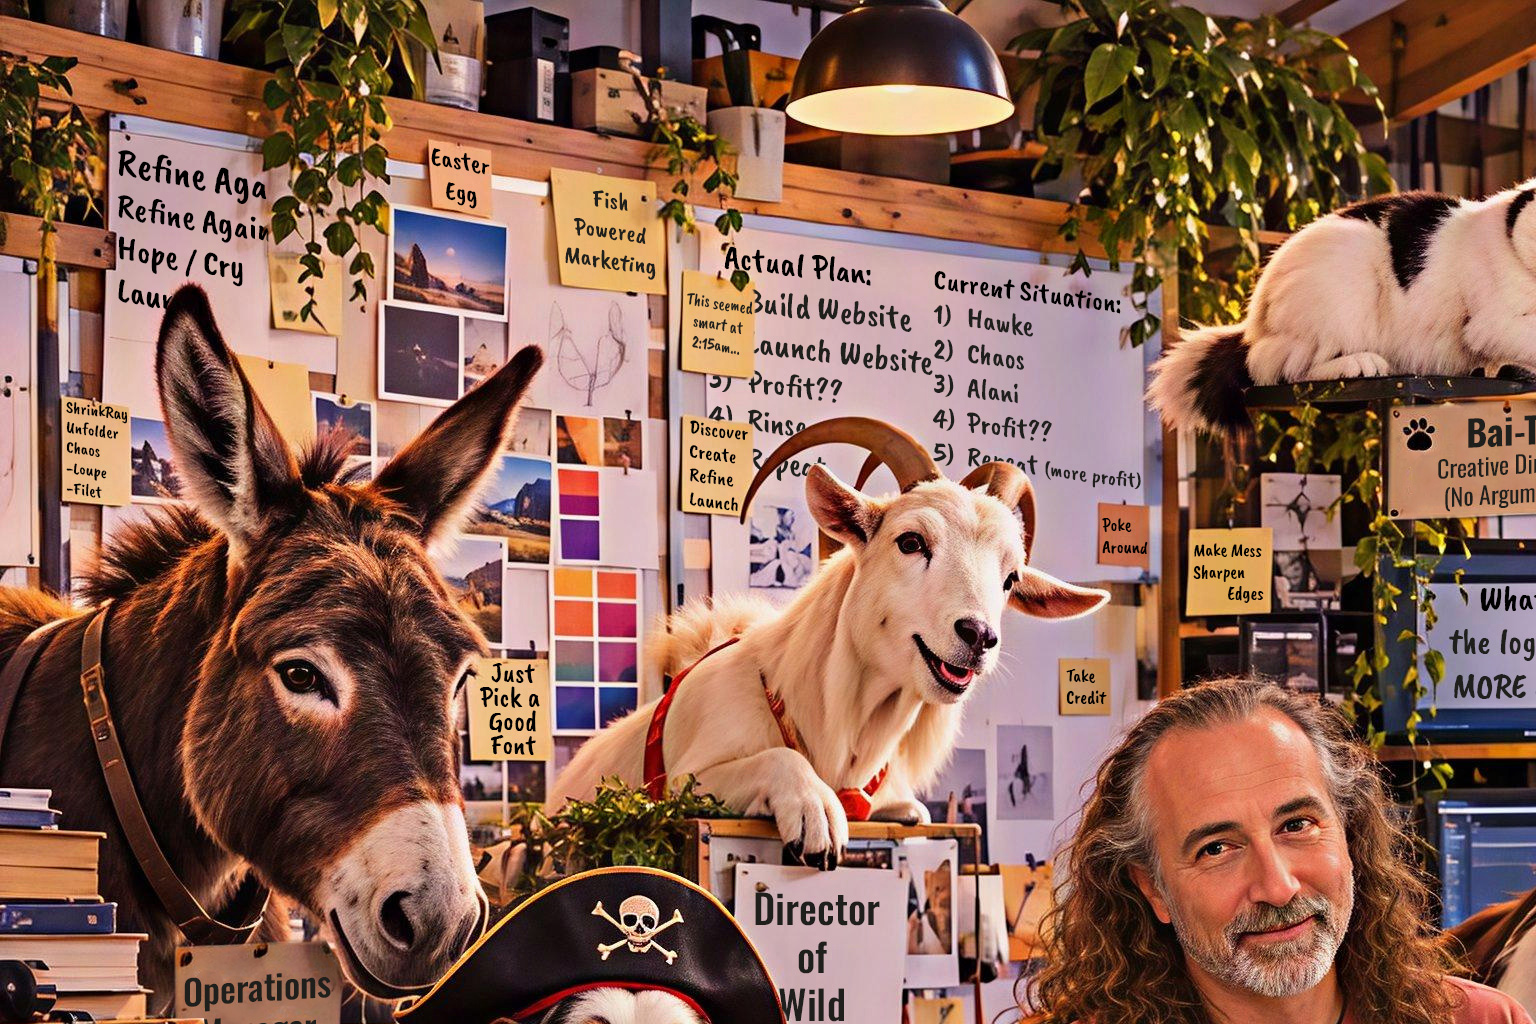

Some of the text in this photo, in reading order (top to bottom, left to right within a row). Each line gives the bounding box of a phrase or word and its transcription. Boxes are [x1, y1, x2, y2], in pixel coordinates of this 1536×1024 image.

[118, 150, 206, 191] Refine
[431, 148, 490, 175] Easter
[446, 182, 477, 208] Egg
[593, 190, 628, 211] Fish
[118, 195, 269, 243] Refine Again
[574, 218, 646, 244] Powered
[119, 236, 178, 274] Hope
[204, 252, 243, 286] Cry
[565, 247, 656, 280] Marketing
[724, 247, 871, 286] Actual Plan:
[934, 270, 1121, 314] Current Situation:
[687, 293, 753, 315] This seemed
[818, 298, 912, 332] Website
[693, 318, 743, 335] smart at
[933, 305, 1034, 337] 1) Hawke
[692, 336, 740, 355] 2:15am...
[934, 339, 1025, 370] 2) Chaos
[753, 339, 933, 375] aunch Website
[749, 370, 843, 403] Profit??
[933, 374, 1019, 404] 3) Alani
[66, 402, 128, 424] ShrinkRay
[67, 422, 119, 439] Unfolder
[690, 421, 748, 441] Discover
[933, 408, 1053, 442] 4) Profit??
[67, 442, 100, 457] Chaos
[690, 445, 736, 464] Create
[67, 464, 107, 481] -Loupe
[933, 443, 954, 466] 5)
[1045, 461, 1087, 482] (more
[1092, 470, 1142, 489] profit)
[1437, 457, 1509, 479] Creative
[690, 468, 734, 487] Refine
[67, 484, 102, 498] -Filet
[1444, 486, 1473, 511] (No
[690, 493, 738, 512] Launch
[1102, 518, 1132, 533] Poke
[1102, 540, 1148, 555] Around
[1193, 544, 1262, 558] Make Mess
[1193, 565, 1245, 583] Sharpen
[1228, 586, 1264, 603] Edges
[1449, 629, 1490, 654] the
[491, 662, 535, 684] Just
[1066, 669, 1095, 684] Take
[1454, 673, 1527, 699] MORE
[480, 687, 540, 708] Pick a
[1066, 690, 1107, 705] Credit
[489, 711, 537, 732] Good
[490, 735, 537, 756] Font
[755, 892, 880, 926] Director
[798, 942, 827, 973] of
[184, 973, 331, 1011] Operations
[779, 988, 845, 1022] Wild
